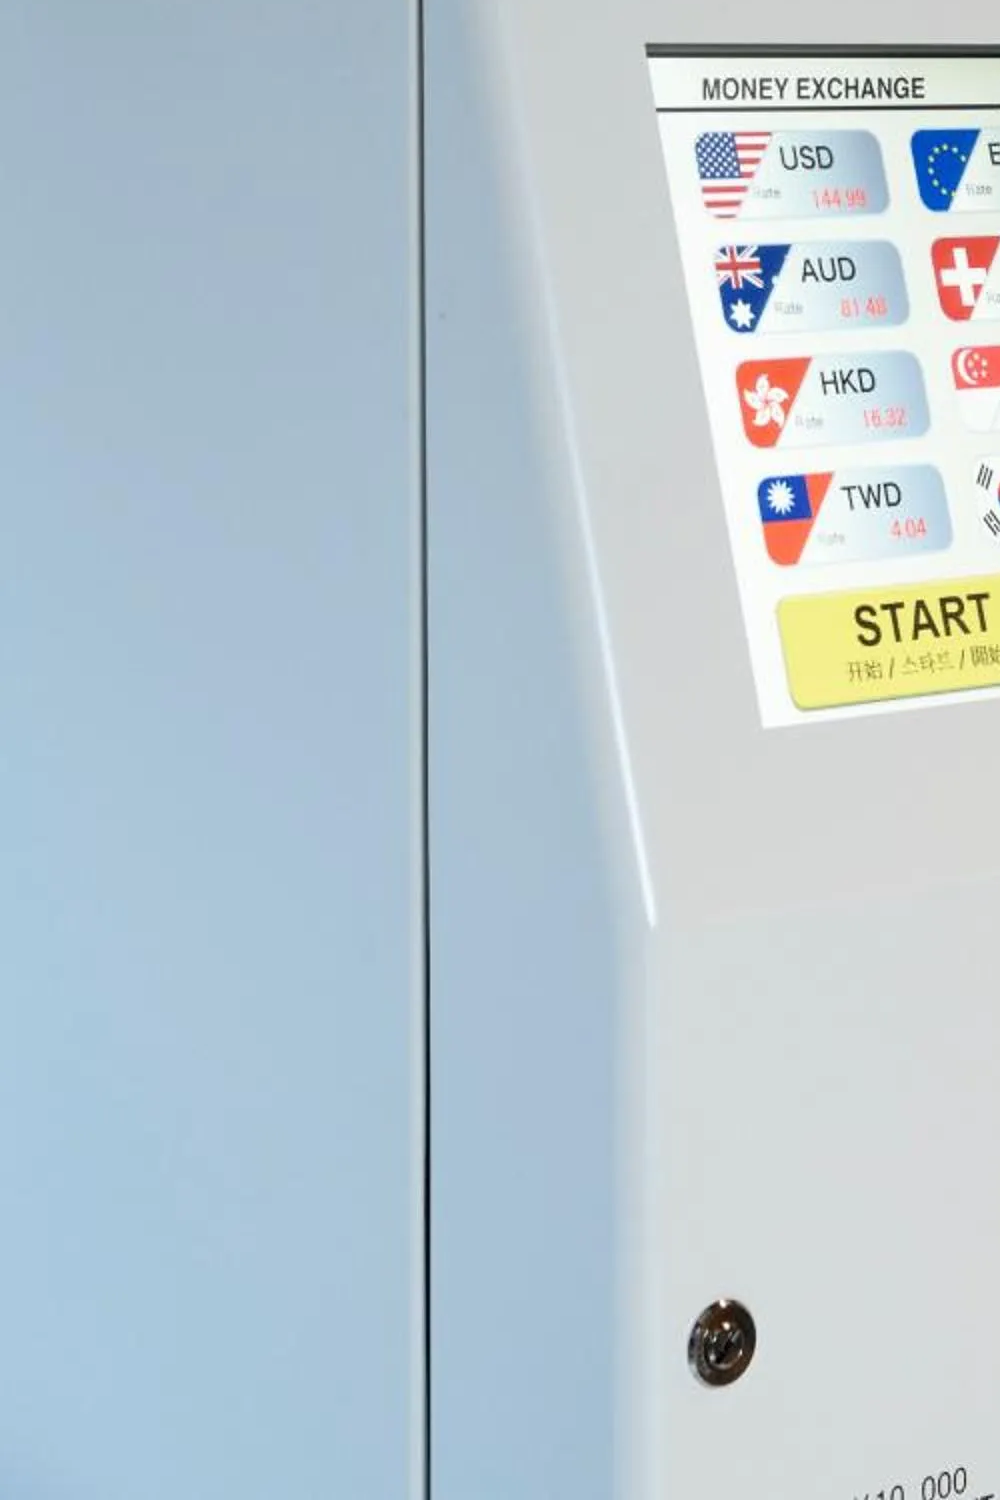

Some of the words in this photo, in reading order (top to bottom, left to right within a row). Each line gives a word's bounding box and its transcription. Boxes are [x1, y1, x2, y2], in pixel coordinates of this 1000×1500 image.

[702, 77, 788, 100] MONEY
[797, 77, 925, 100] EXCHANGE
[779, 146, 834, 170] USD
[802, 256, 857, 283] AUD
[820, 368, 876, 396] HKD
[840, 482, 902, 511] TWD
[854, 592, 990, 647] START
